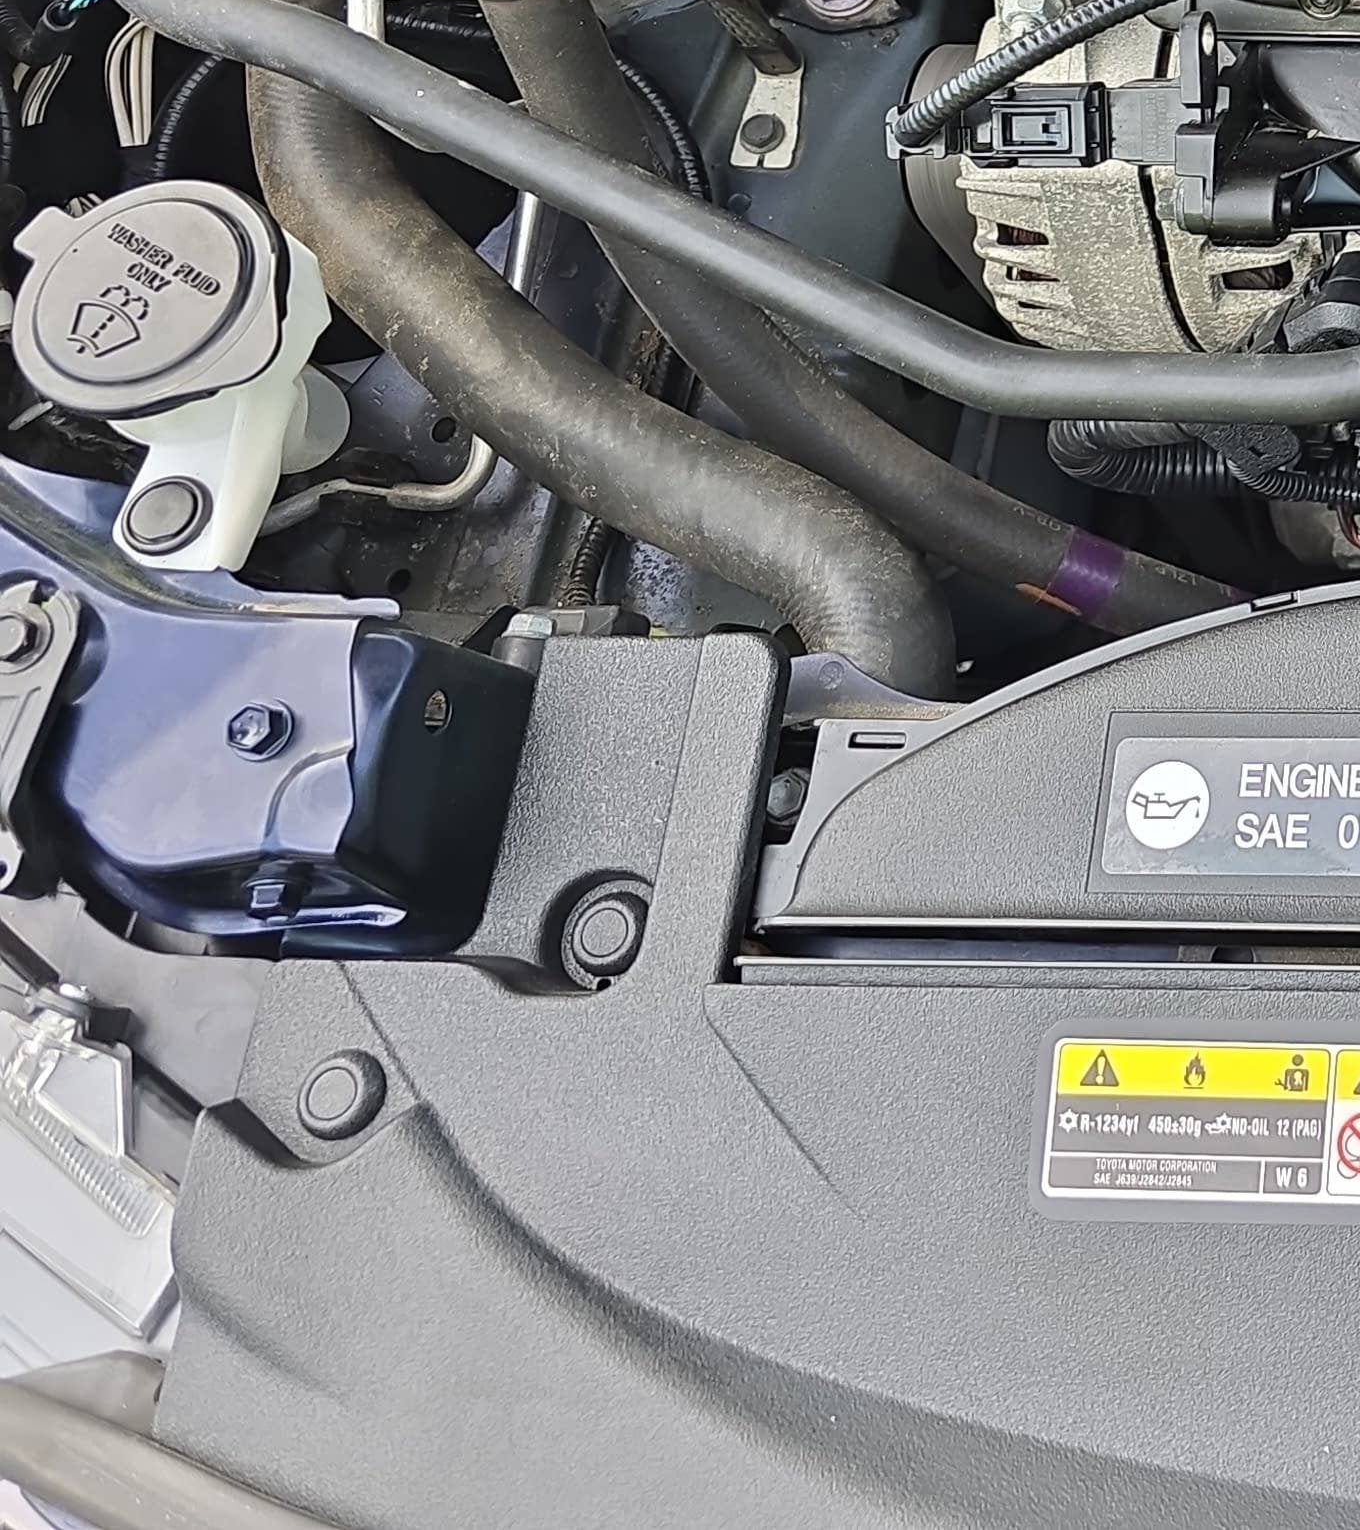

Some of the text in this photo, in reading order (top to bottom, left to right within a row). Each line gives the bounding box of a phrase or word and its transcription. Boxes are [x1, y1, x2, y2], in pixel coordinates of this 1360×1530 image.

[106, 222, 221, 298] WASHER FLUID
[127, 262, 173, 293] ONLY
[1234, 813, 1310, 850] SAE
[1148, 1116, 1202, 1138] 450±30g
[1232, 1118, 1269, 1136] ND-OIL
[1276, 1119, 1289, 1136] 12
[1292, 1119, 1322, 1140] (PAG)
[1096, 1158, 1216, 1172] TOYOTA MOTOR CORPORATION
[1094, 1173, 1110, 1185] SAE
[1276, 1168, 1308, 1187] W 6
